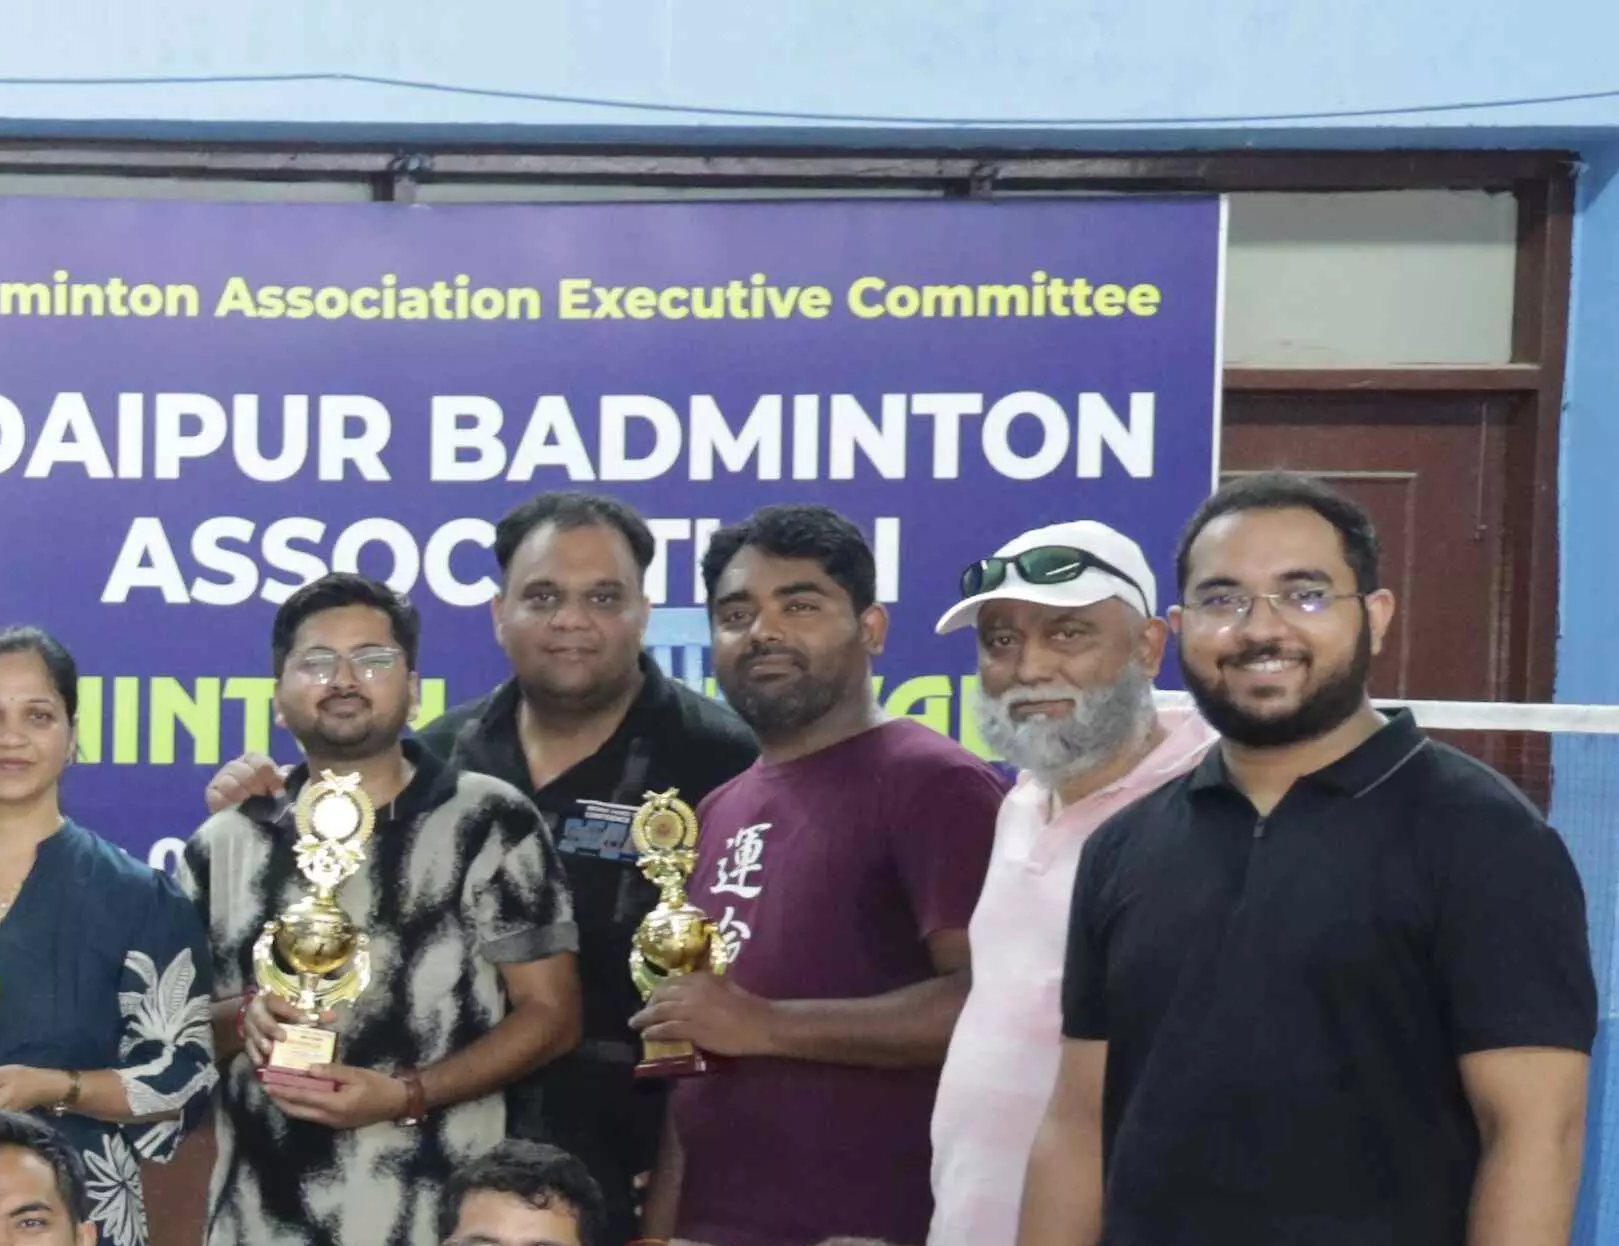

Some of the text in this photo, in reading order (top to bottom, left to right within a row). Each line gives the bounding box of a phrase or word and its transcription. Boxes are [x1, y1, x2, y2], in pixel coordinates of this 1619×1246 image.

[215, 273, 541, 321] Association
[557, 274, 832, 320] Executive
[847, 271, 1161, 319] Committee
[430, 391, 1156, 482] BADMINTON
